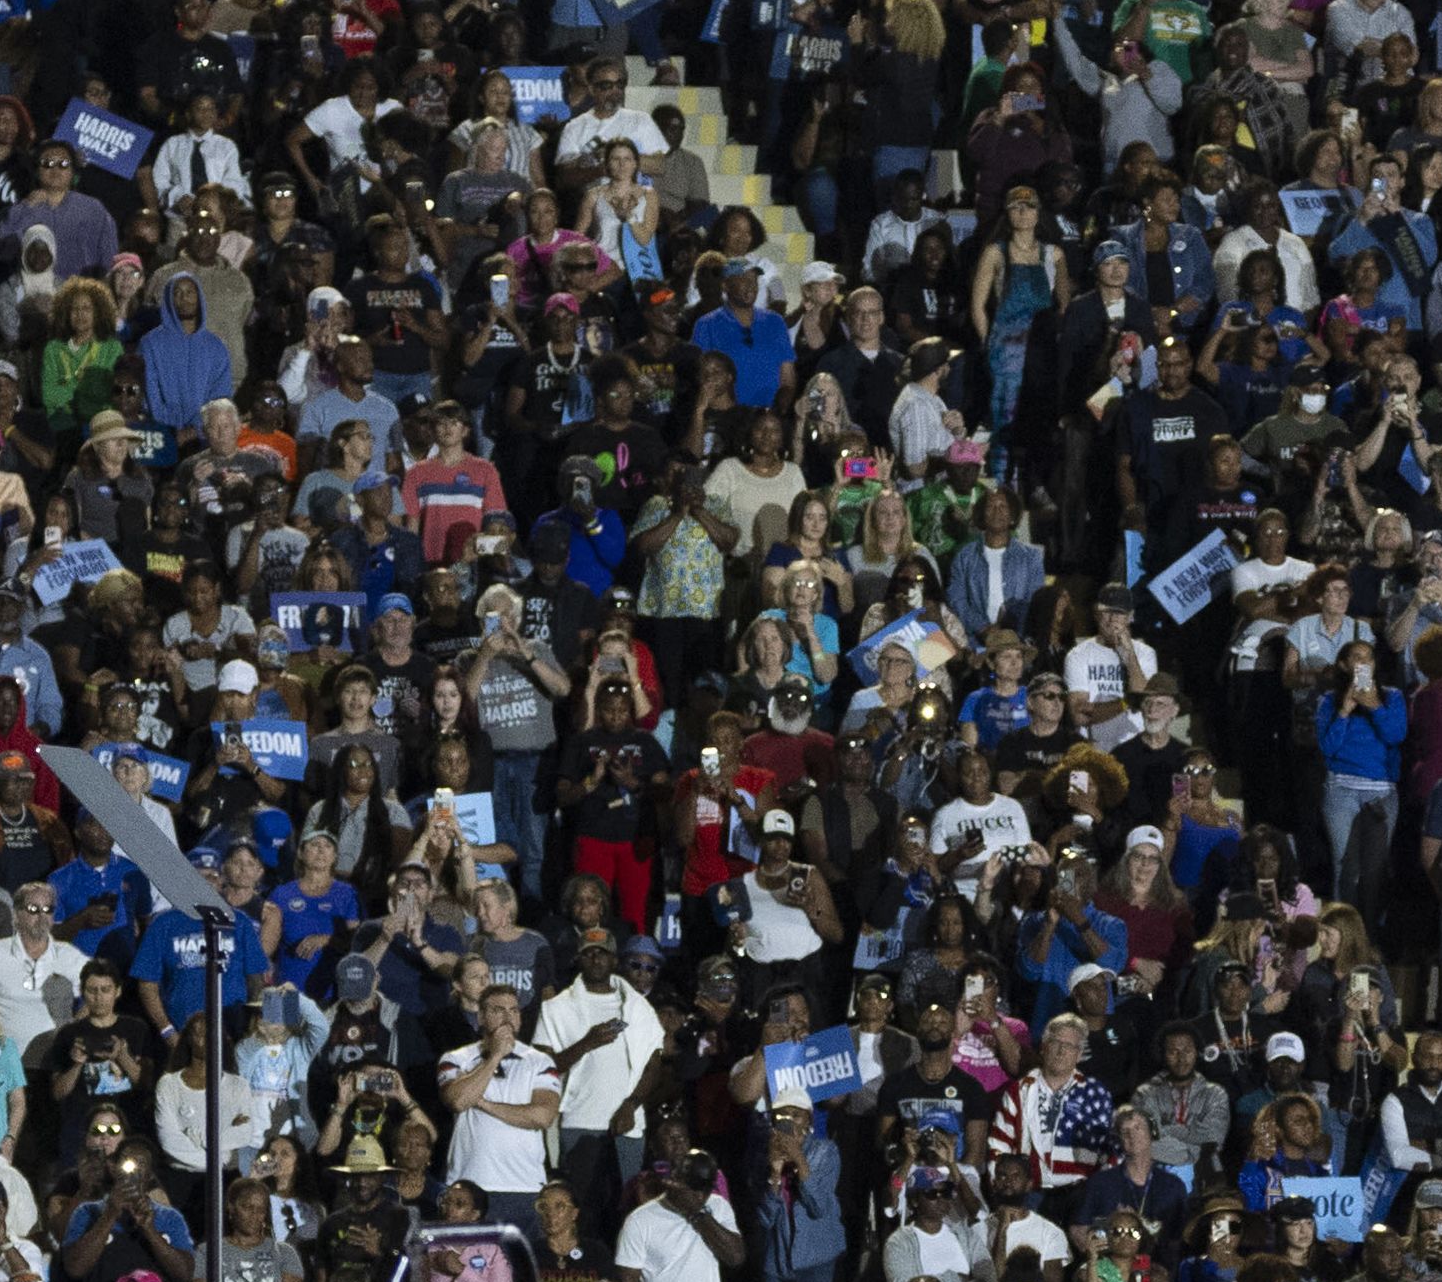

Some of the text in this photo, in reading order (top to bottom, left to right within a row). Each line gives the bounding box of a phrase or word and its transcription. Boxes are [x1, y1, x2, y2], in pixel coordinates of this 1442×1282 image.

[78, 113, 136, 152] HARRIS
[80, 132, 120, 159] WALZ
[1089, 666, 1122, 681] HARR
[222, 732, 302, 758] EEDOM
[1316, 1189, 1355, 1219] ote
